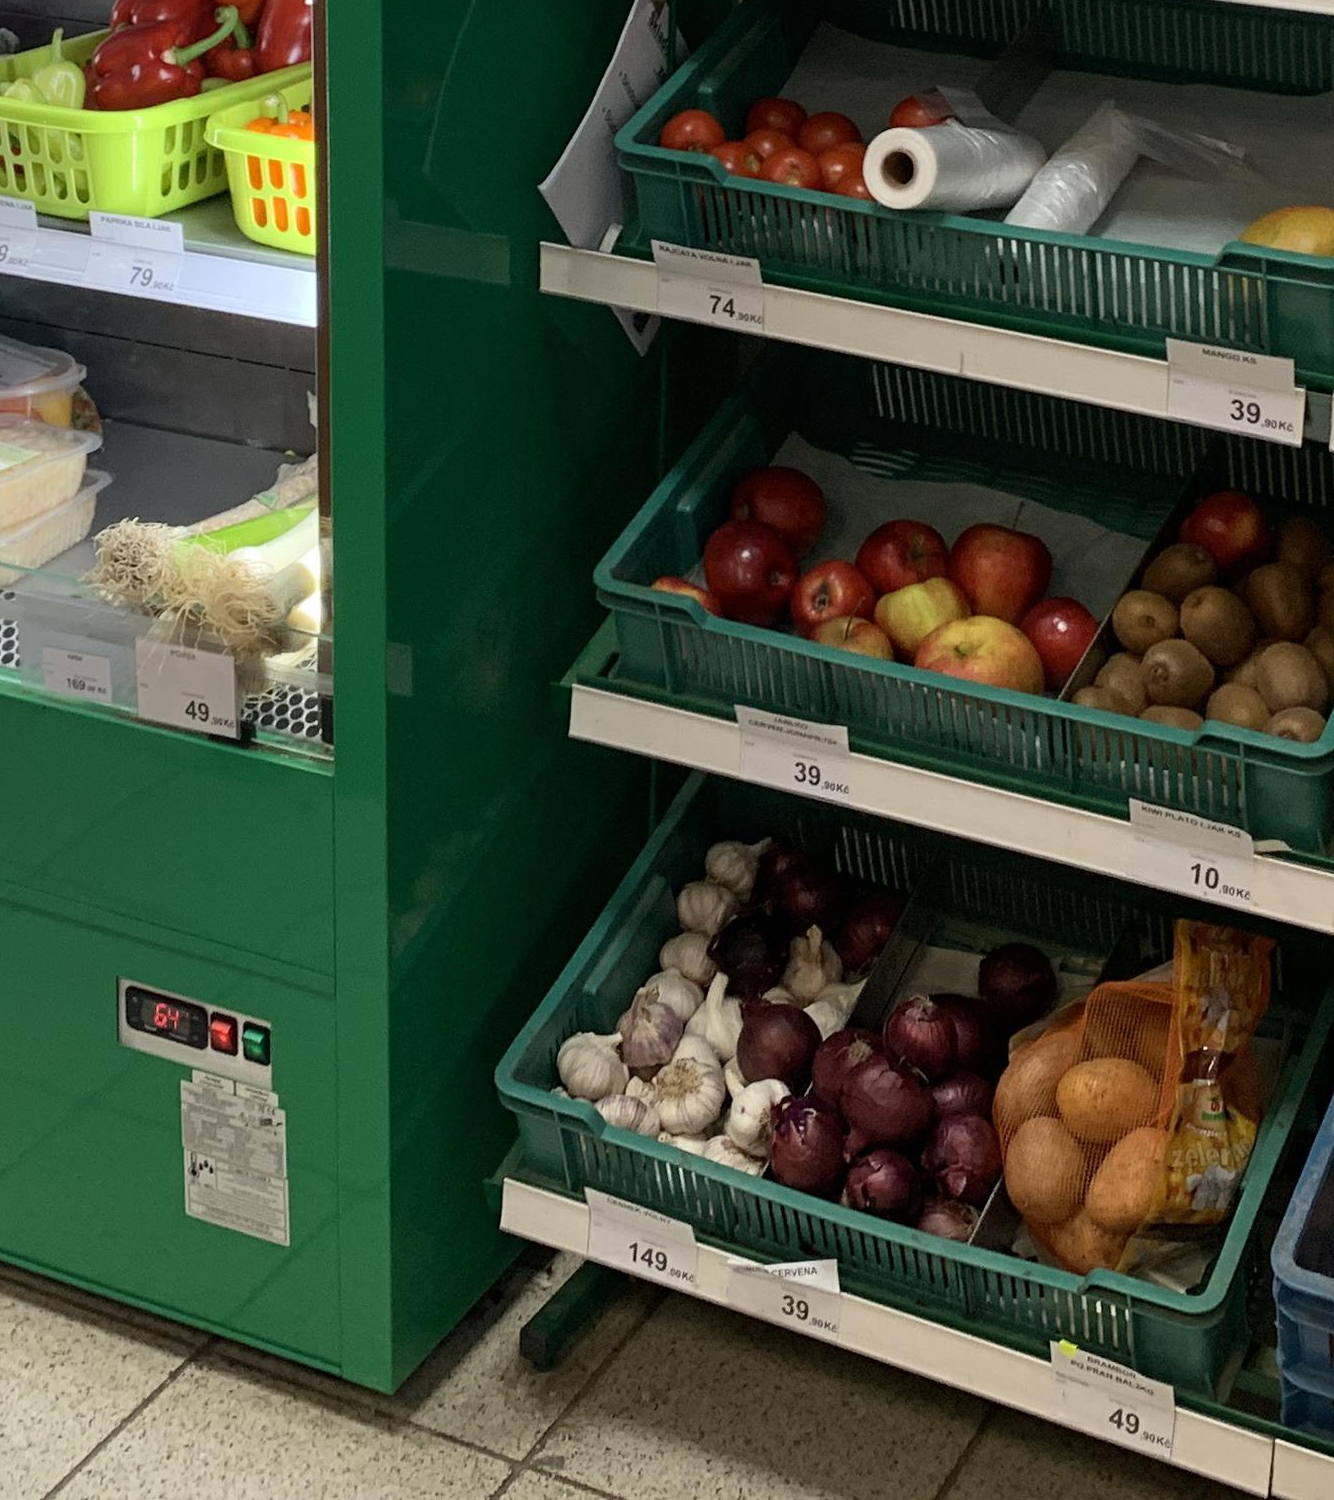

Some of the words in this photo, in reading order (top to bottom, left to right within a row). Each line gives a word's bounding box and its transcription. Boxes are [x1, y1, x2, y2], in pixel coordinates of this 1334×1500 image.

[1201, 346, 1241, 363] MANGO
[1242, 354, 1257, 366] KS
[1140, 804, 1164, 818] KIWI
[770, 1266, 819, 1279] CERVENA
